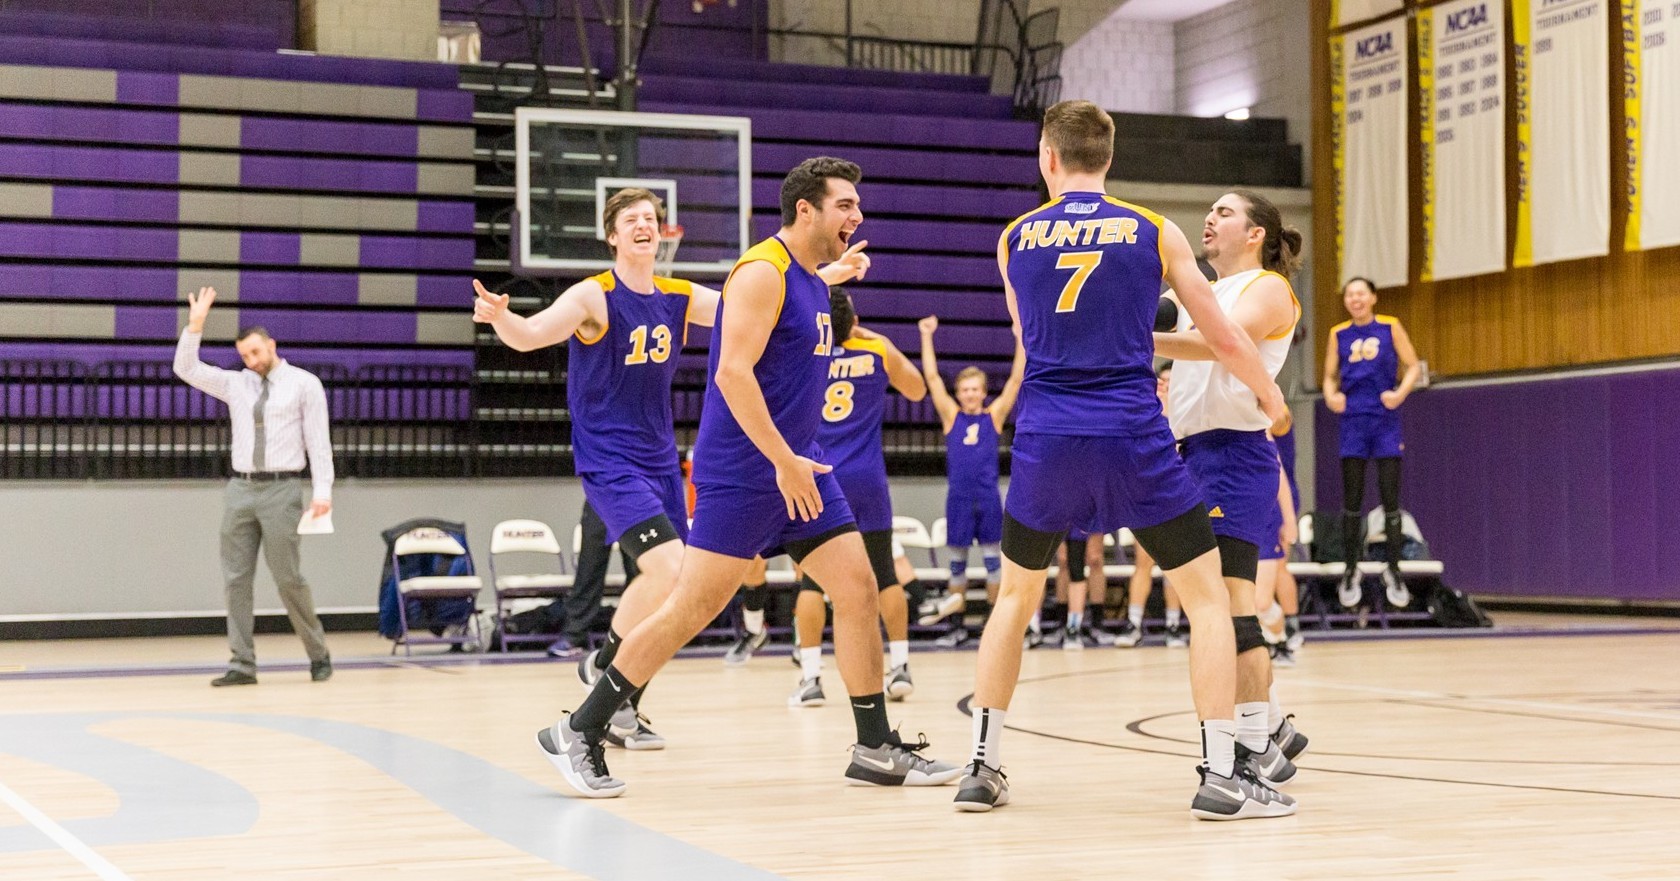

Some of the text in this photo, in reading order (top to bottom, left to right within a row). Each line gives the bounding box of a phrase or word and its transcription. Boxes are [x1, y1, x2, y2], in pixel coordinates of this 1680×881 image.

[1445, 4, 1487, 34] NCAA
[1355, 31, 1393, 59] NCAA
[1017, 216, 1139, 251] HUNTER
[1055, 250, 1104, 313] 7
[624, 323, 672, 366] 13
[1348, 336, 1381, 363] 16
[821, 380, 855, 423] 8
[962, 422, 980, 446] 1
